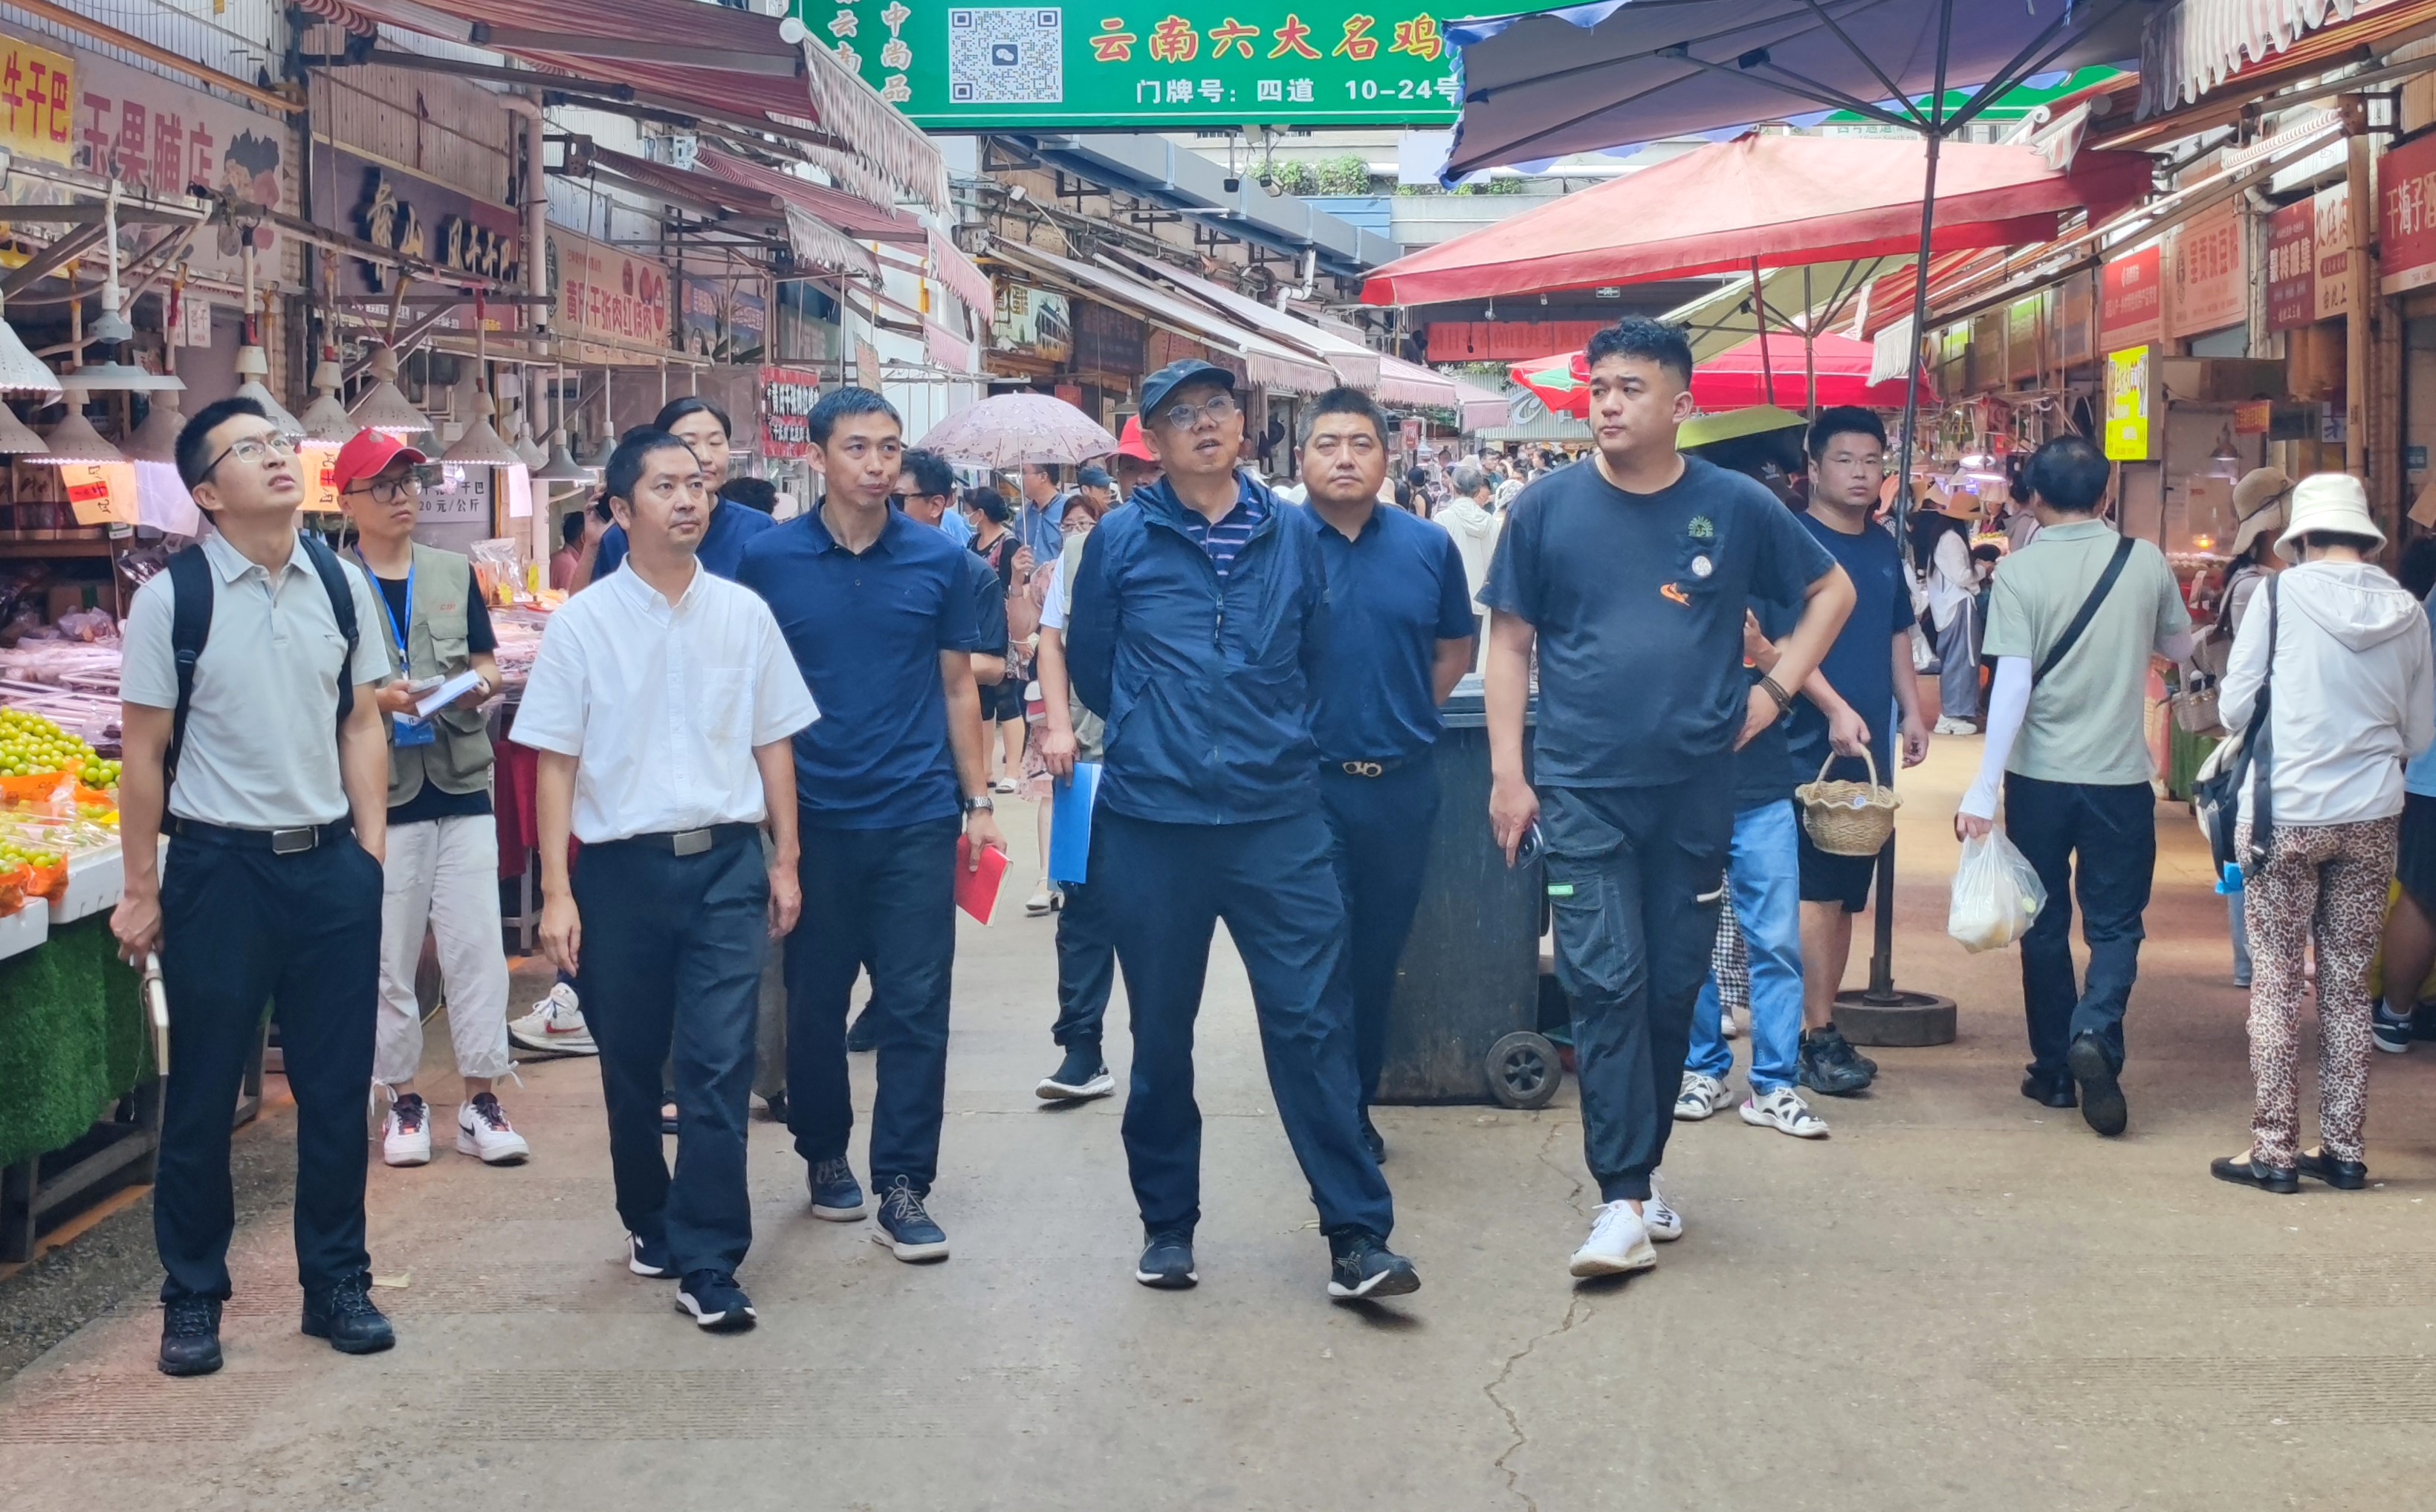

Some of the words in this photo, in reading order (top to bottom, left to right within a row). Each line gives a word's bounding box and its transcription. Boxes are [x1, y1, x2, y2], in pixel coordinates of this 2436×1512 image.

[1089, 13, 1443, 62] 云南六大名鸡
[1, 50, 68, 143] 牛干巴
